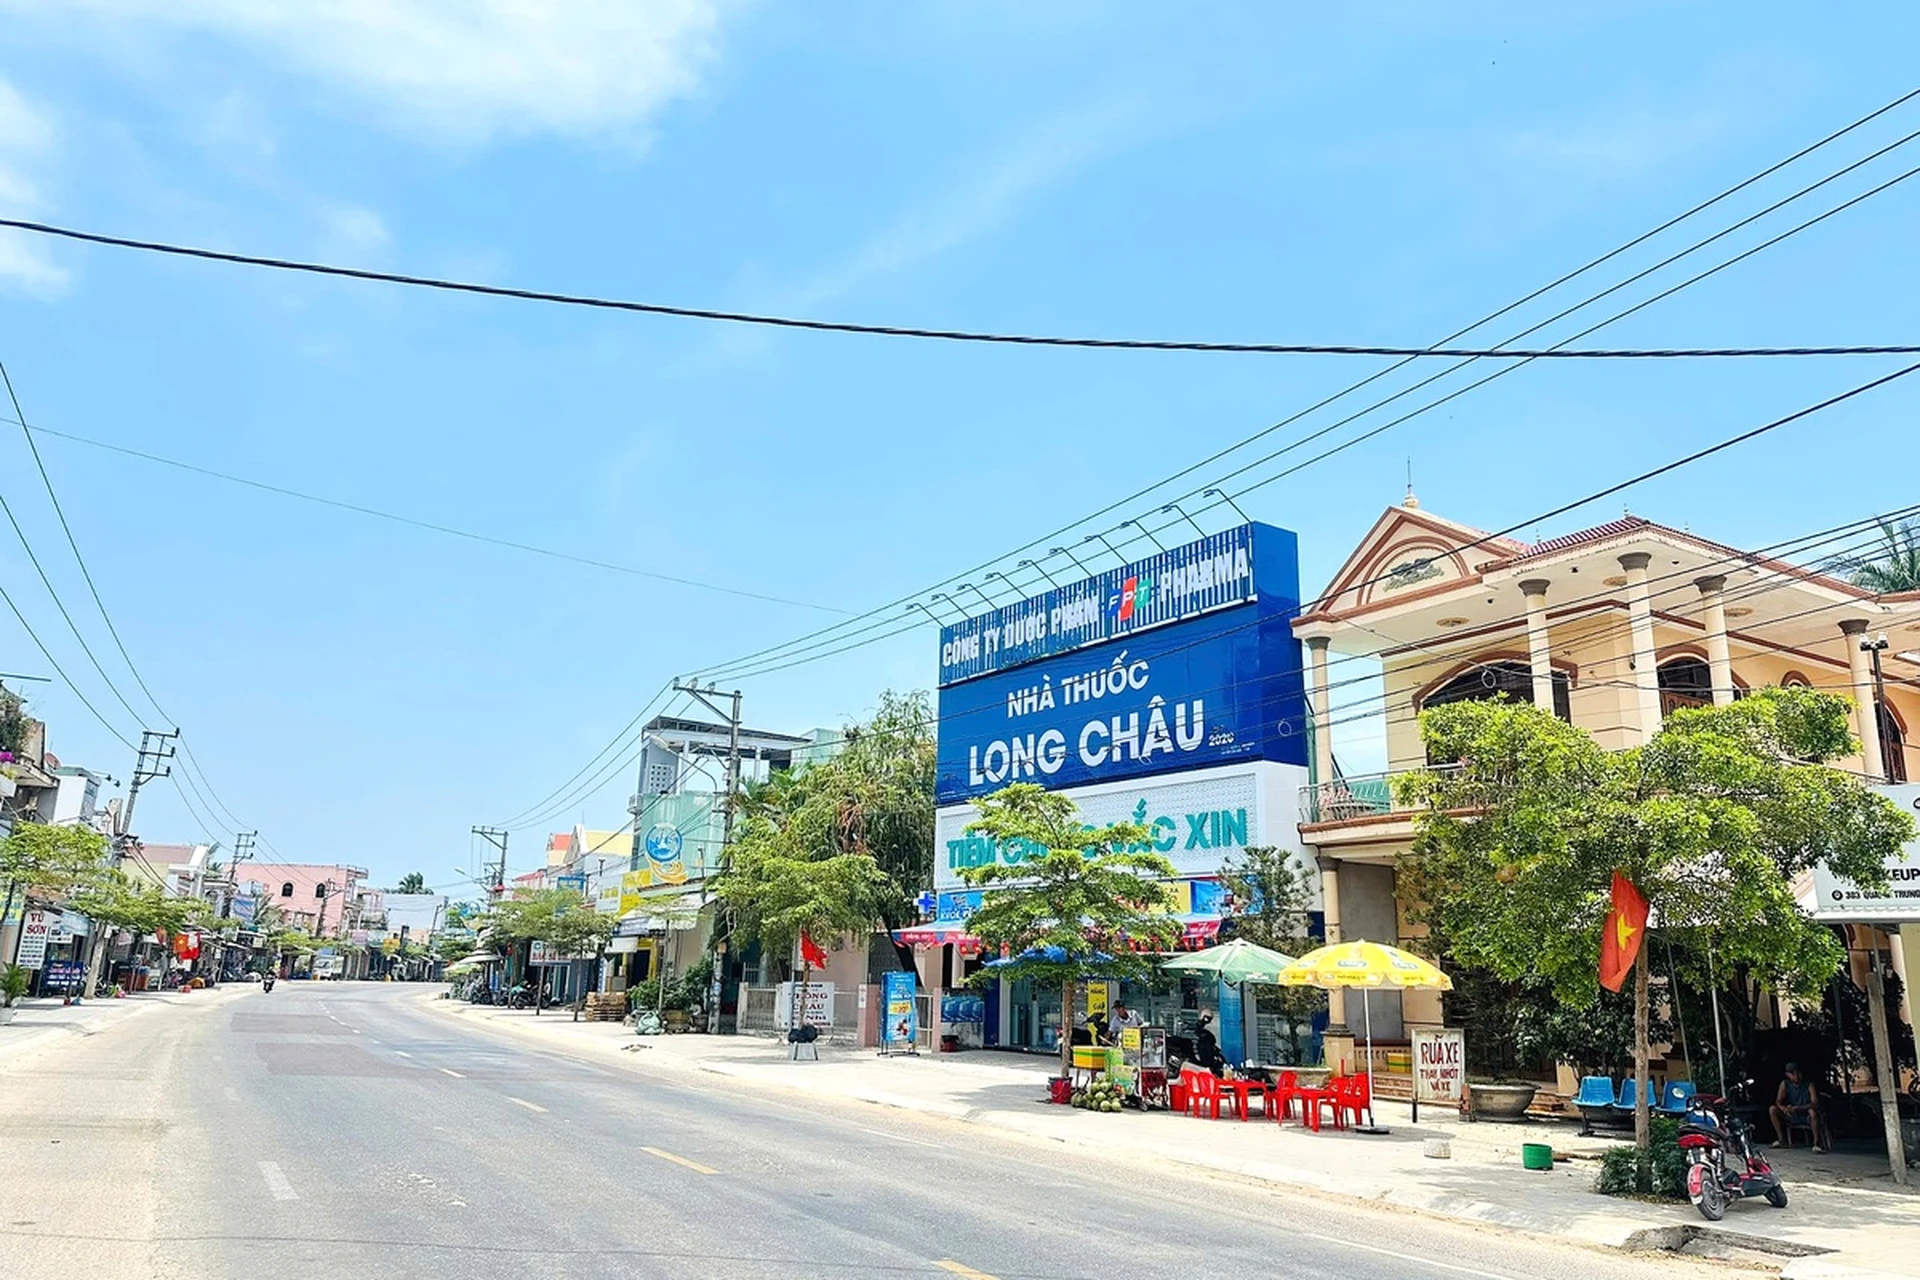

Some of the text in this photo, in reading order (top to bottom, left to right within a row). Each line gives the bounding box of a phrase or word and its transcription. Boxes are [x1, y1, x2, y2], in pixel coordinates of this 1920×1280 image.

[943, 634, 980, 667] CÔNG
[984, 626, 1000, 655] TY
[1108, 583, 1149, 613] FPT
[1160, 547, 1249, 602] PHARMA
[1007, 649, 1149, 718] NHÀ THUỐC
[969, 695, 1204, 787] LONG CHÂU
[1184, 808, 1248, 850] XIN
[1444, 1042, 1459, 1064] XE
